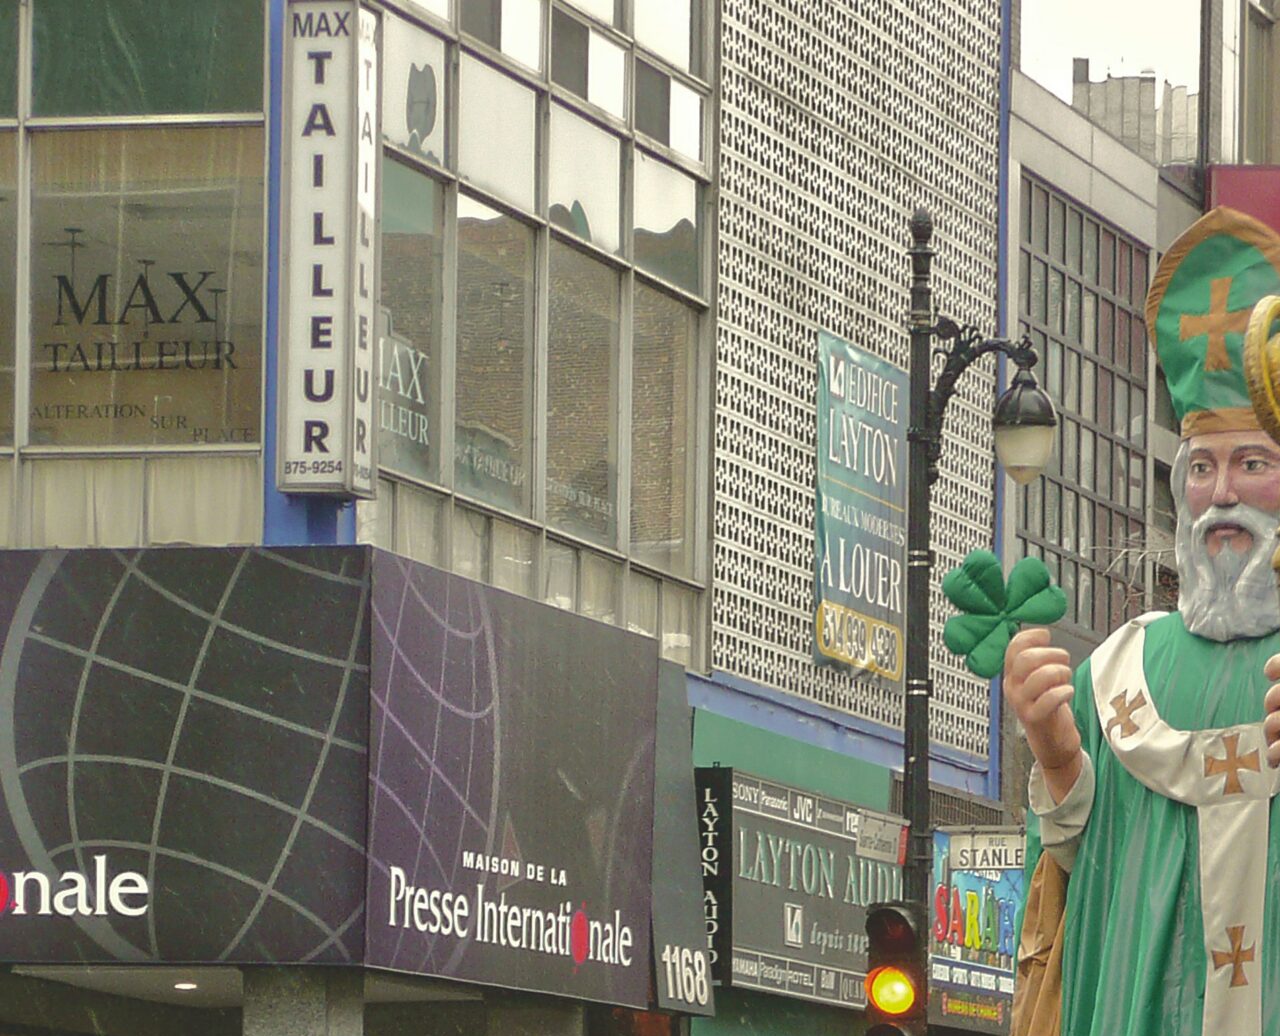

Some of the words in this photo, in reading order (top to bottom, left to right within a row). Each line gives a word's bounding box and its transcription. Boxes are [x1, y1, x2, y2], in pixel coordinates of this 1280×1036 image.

[292, 11, 351, 38] MAX
[301, 50, 336, 455] TAILLEUR
[356, 59, 373, 454] TAILLEUR
[52, 270, 217, 326] MAX
[43, 340, 239, 373] TAILLEUR
[150, 415, 188, 430] SUR
[848, 362, 899, 425] EDIFICE
[829, 407, 898, 488] LAYTON
[838, 537, 902, 614] LOUER
[732, 782, 759, 804] SONY
[793, 795, 813, 824] JVC
[701, 788, 720, 877] LAYTON
[738, 826, 836, 899] LAYTON
[988, 836, 1007, 848] RUE
[462, 850, 520, 877] MAISON
[526, 863, 544, 882] DE
[550, 867, 567, 886] LA
[388, 866, 469, 938] Presse
[662, 943, 710, 1006] 1168
